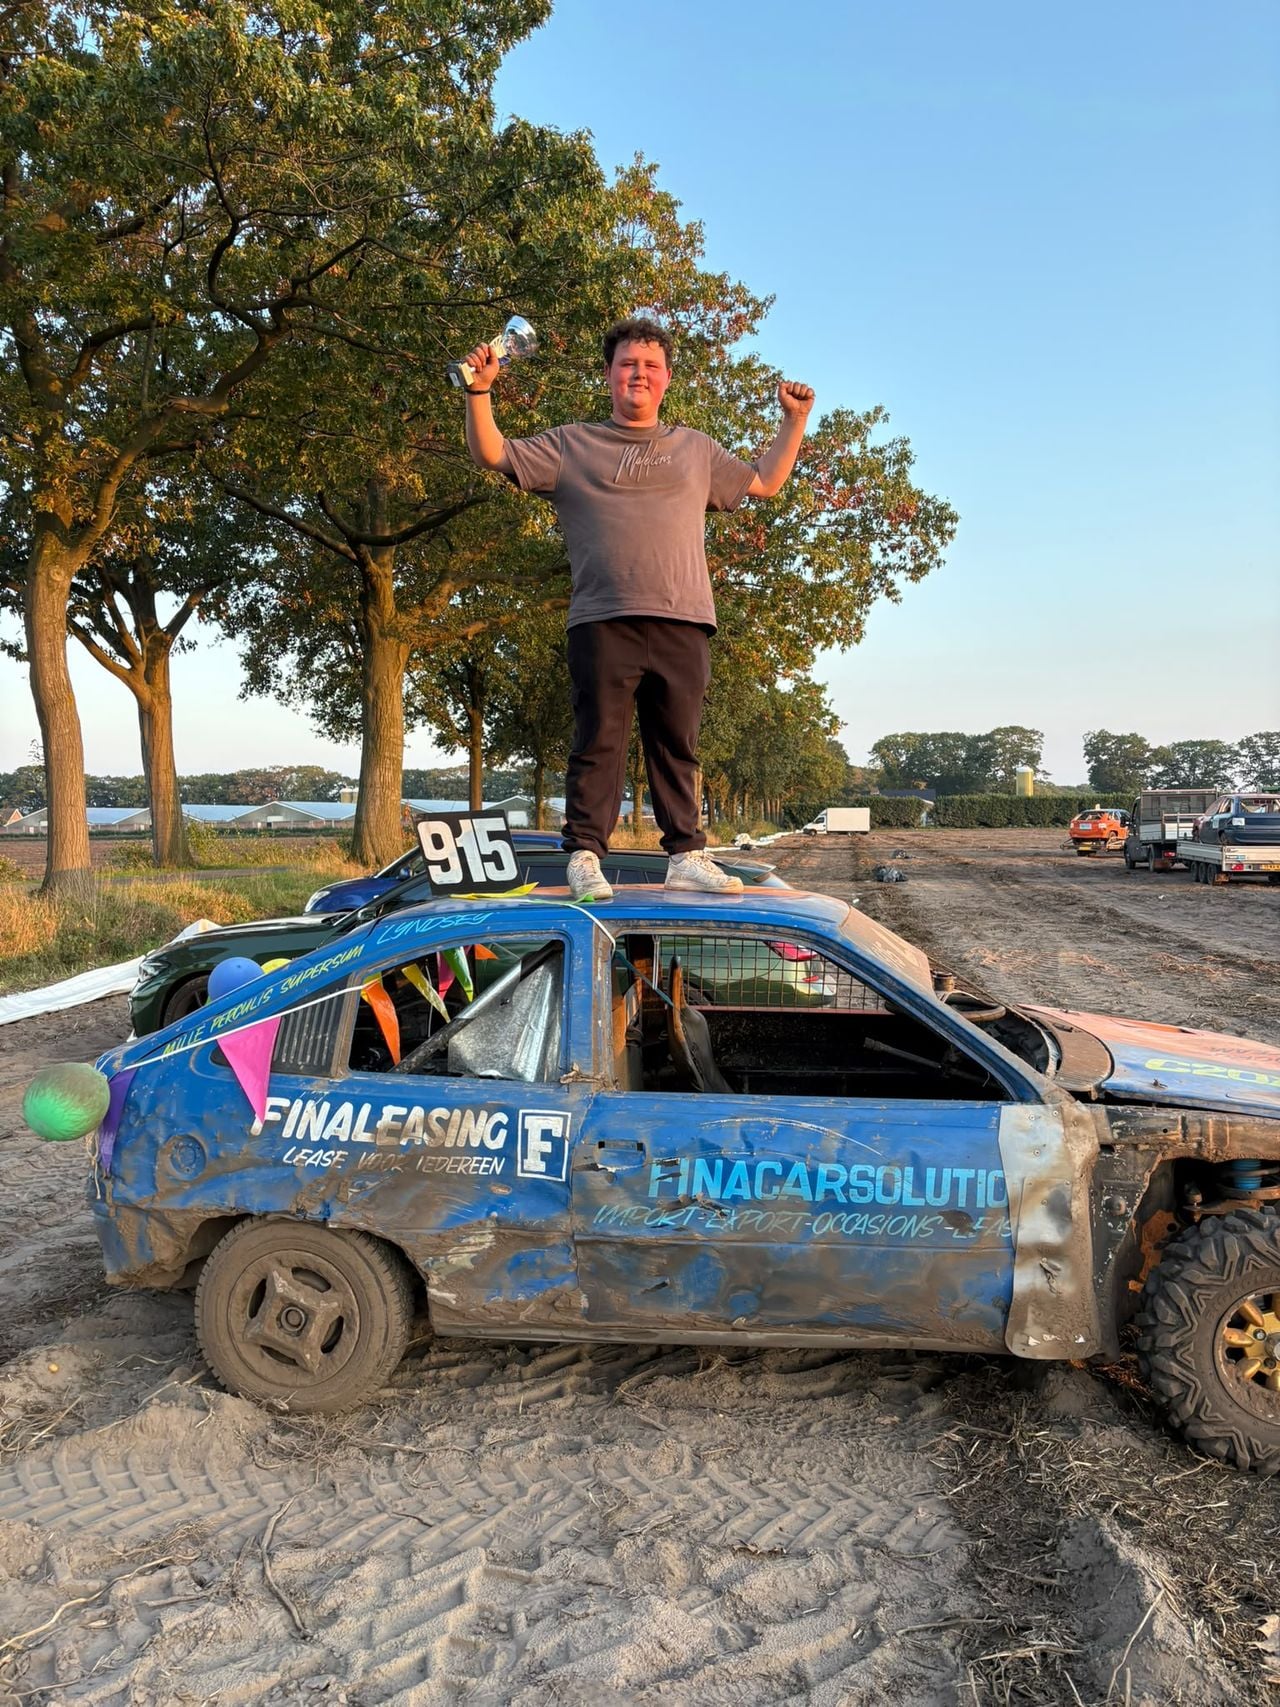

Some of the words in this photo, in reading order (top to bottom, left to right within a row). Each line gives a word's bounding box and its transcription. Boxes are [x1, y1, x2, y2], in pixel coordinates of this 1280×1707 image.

[417, 817, 518, 885] 915
[279, 943, 365, 995] SUPERSUM
[250, 1096, 510, 1150] FINALEASING
[522, 1114, 565, 1173] F
[282, 1145, 349, 1170] LEASE
[415, 1155, 506, 1176] IEDEREEN
